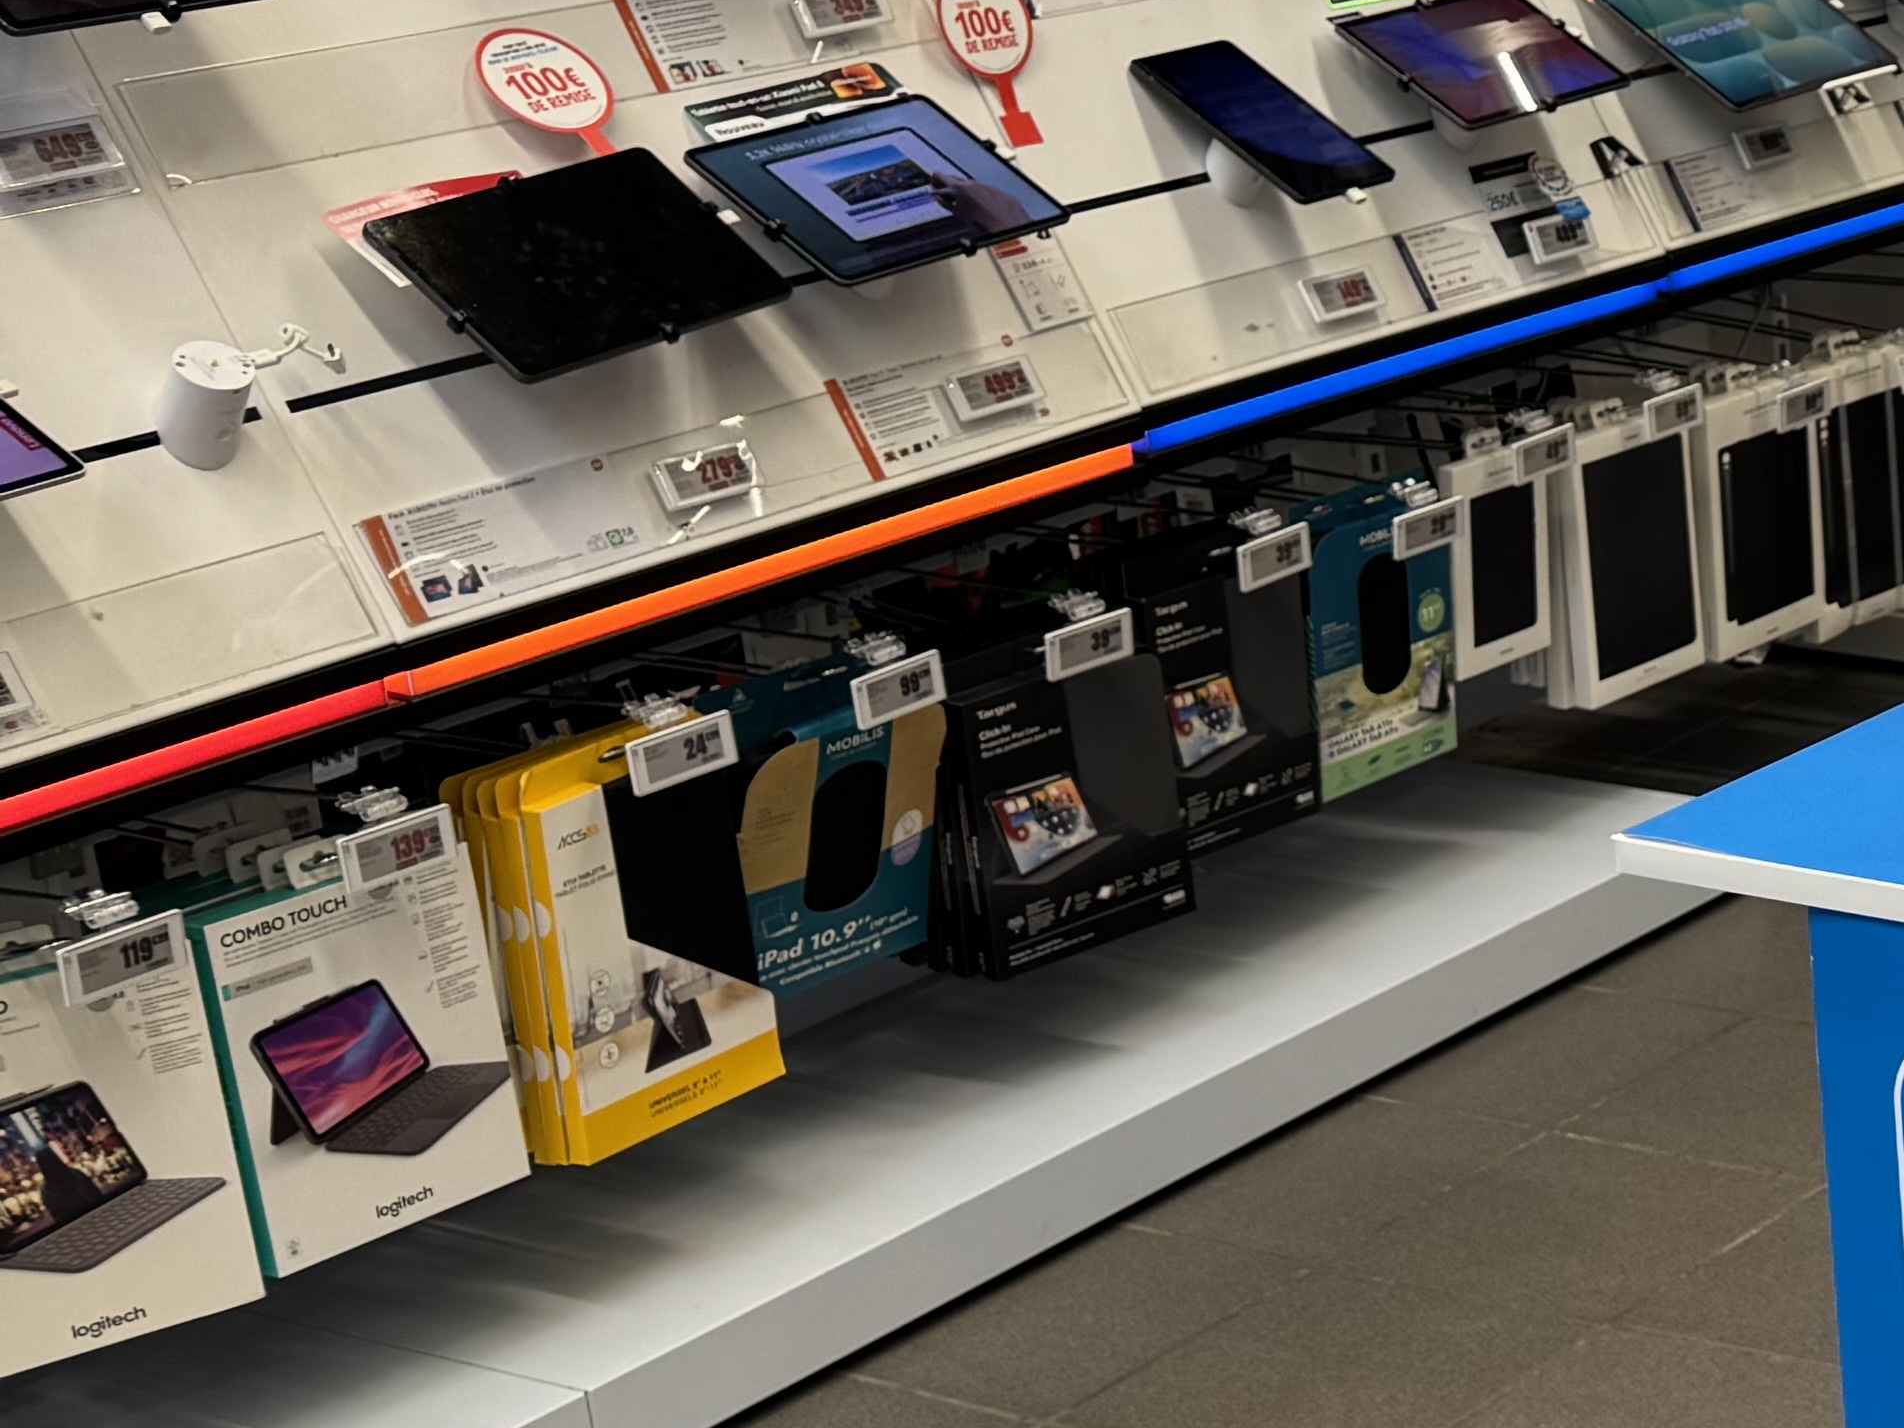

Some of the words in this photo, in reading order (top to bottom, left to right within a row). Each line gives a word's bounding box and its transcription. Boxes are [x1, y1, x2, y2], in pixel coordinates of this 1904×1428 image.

[954, 6, 1016, 40] 100€
[504, 64, 589, 98] 100€
[527, 98, 545, 114] DE
[546, 86, 599, 113] REMISE
[976, 701, 1018, 721] Targus
[825, 724, 885, 756] MOBILIS
[218, 909, 286, 950] COMBO
[286, 893, 350, 932] TOUCH
[757, 938, 803, 972] iPad
[374, 1183, 435, 1222] logitech
[69, 1304, 148, 1343] logitech
